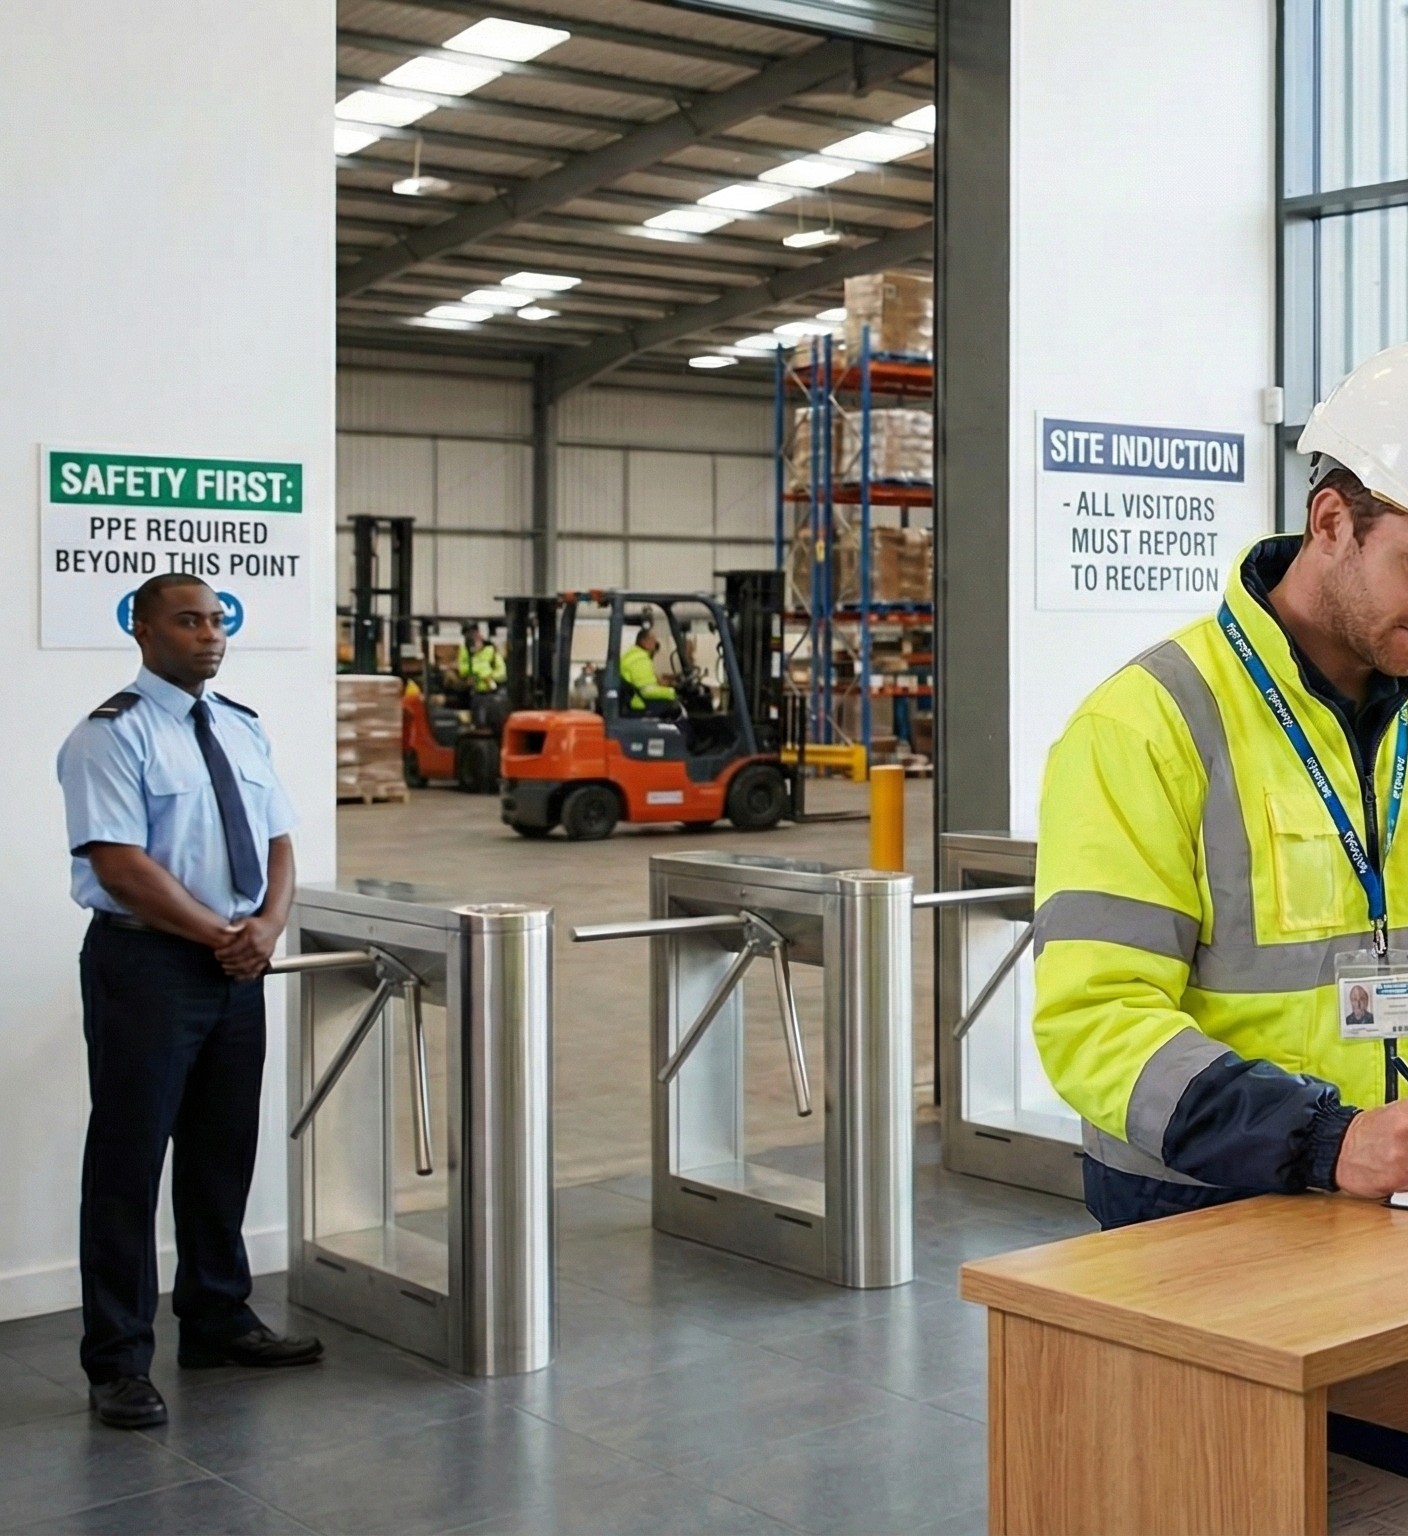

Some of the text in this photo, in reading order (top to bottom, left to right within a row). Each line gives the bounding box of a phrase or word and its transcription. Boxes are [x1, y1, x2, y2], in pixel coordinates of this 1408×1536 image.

[1050, 429, 1239, 474] SITE INDUCTION
[60, 462, 293, 504] SAFETY FIRST:
[1076, 491, 1115, 517] ALL
[1121, 493, 1215, 522] VISITORS
[90, 516, 268, 545] PPE REQUIRED
[1072, 527, 1218, 557] MUST REPORT
[55, 549, 300, 577] BEYOND THIS POINT
[1071, 564, 1218, 592] TO RECEPTION
